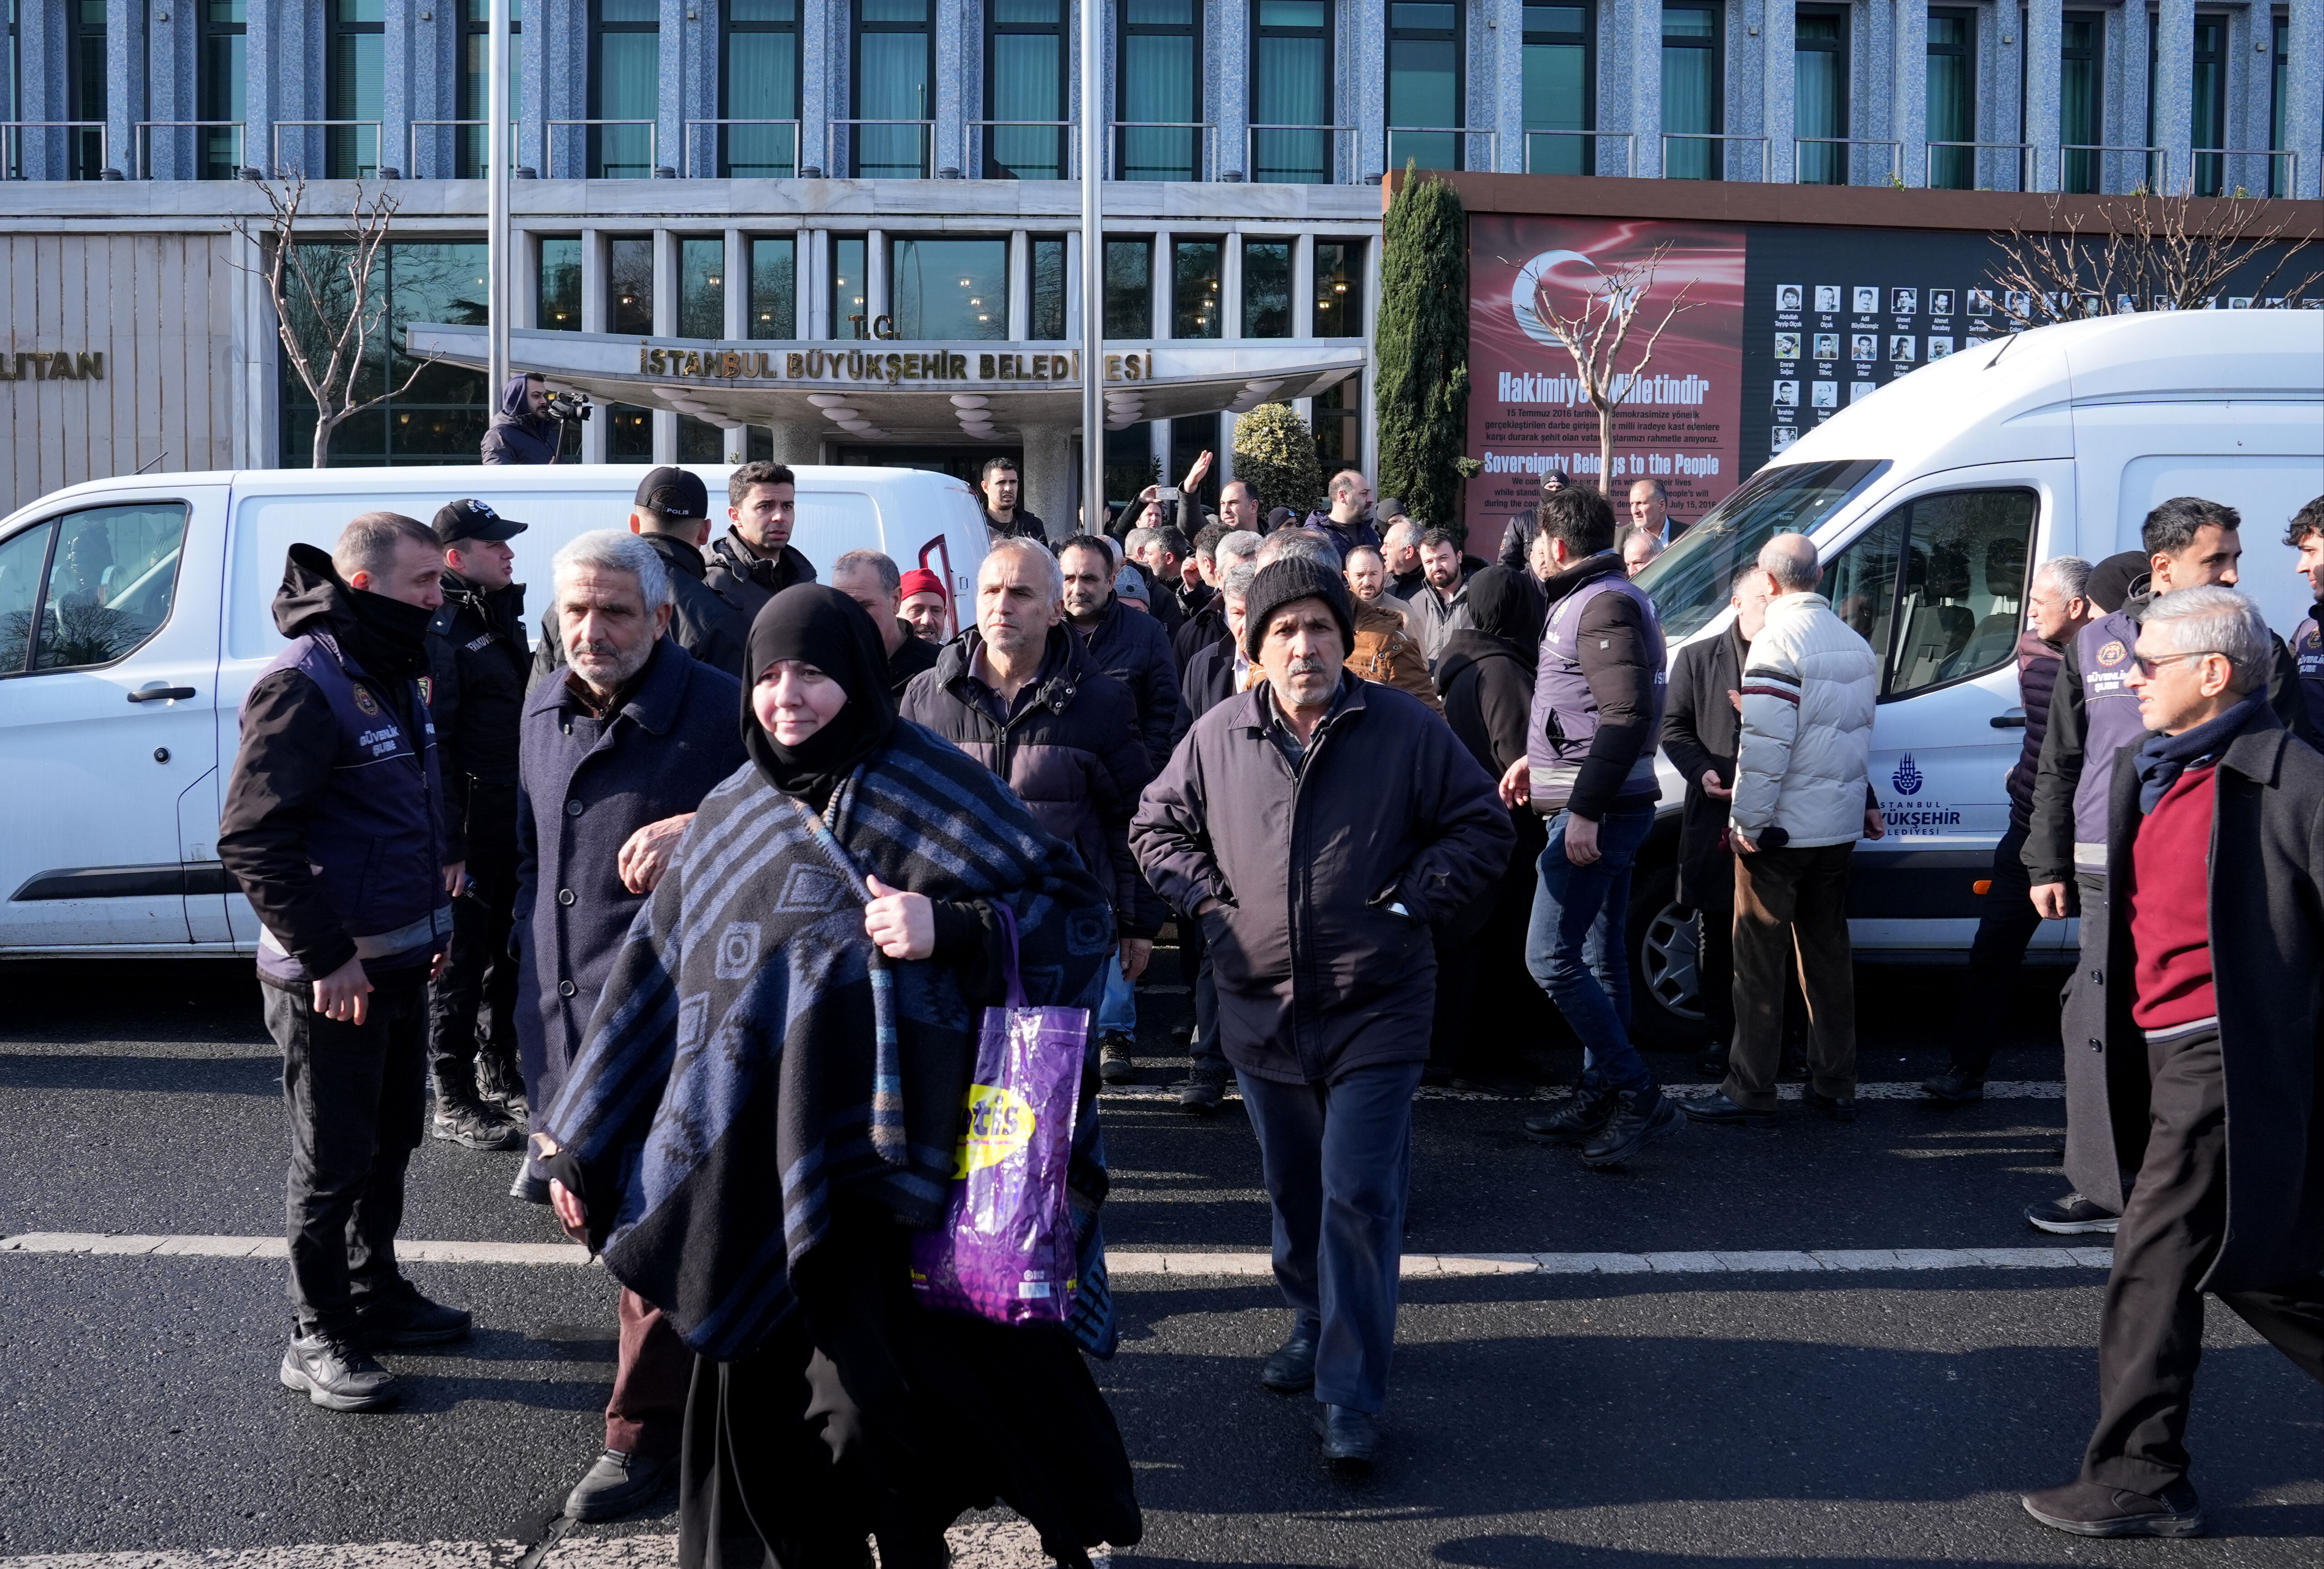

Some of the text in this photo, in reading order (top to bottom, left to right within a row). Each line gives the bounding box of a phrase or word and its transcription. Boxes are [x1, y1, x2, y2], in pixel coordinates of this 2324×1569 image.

[848, 315, 901, 340] T.C.
[640, 339, 1153, 385] İSTANBUL BÜYÜKŞEHİR BELEDİESİ
[1498, 372, 1709, 408] Hakimiye Milletindir
[1507, 409, 1515, 417] 15
[1518, 409, 1550, 418] Temmuz
[1552, 409, 1571, 418] 2016
[1612, 410, 1670, 418] demokrasimize
[1672, 411, 1700, 420] yönelik
[1485, 421, 1546, 431] gerçekleştirilen
[1573, 422, 1599, 431] girişim
[1637, 423, 1667, 432] iradeye
[1486, 433, 1505, 442] karşı
[1541, 433, 1560, 443] şehit
[1684, 436, 1719, 444] anıyoruz.
[1485, 451, 1719, 478] Sovereignty Belogs to the People
[1485, 500, 1508, 509] during
[1669, 501, 1684, 509] July
[2094, 681, 2119, 693] ŞUBE
[360, 724, 400, 746] GÜVENLİK
[373, 740, 397, 757] ŞUBE
[1888, 827, 1939, 835] LEDİYESİ
